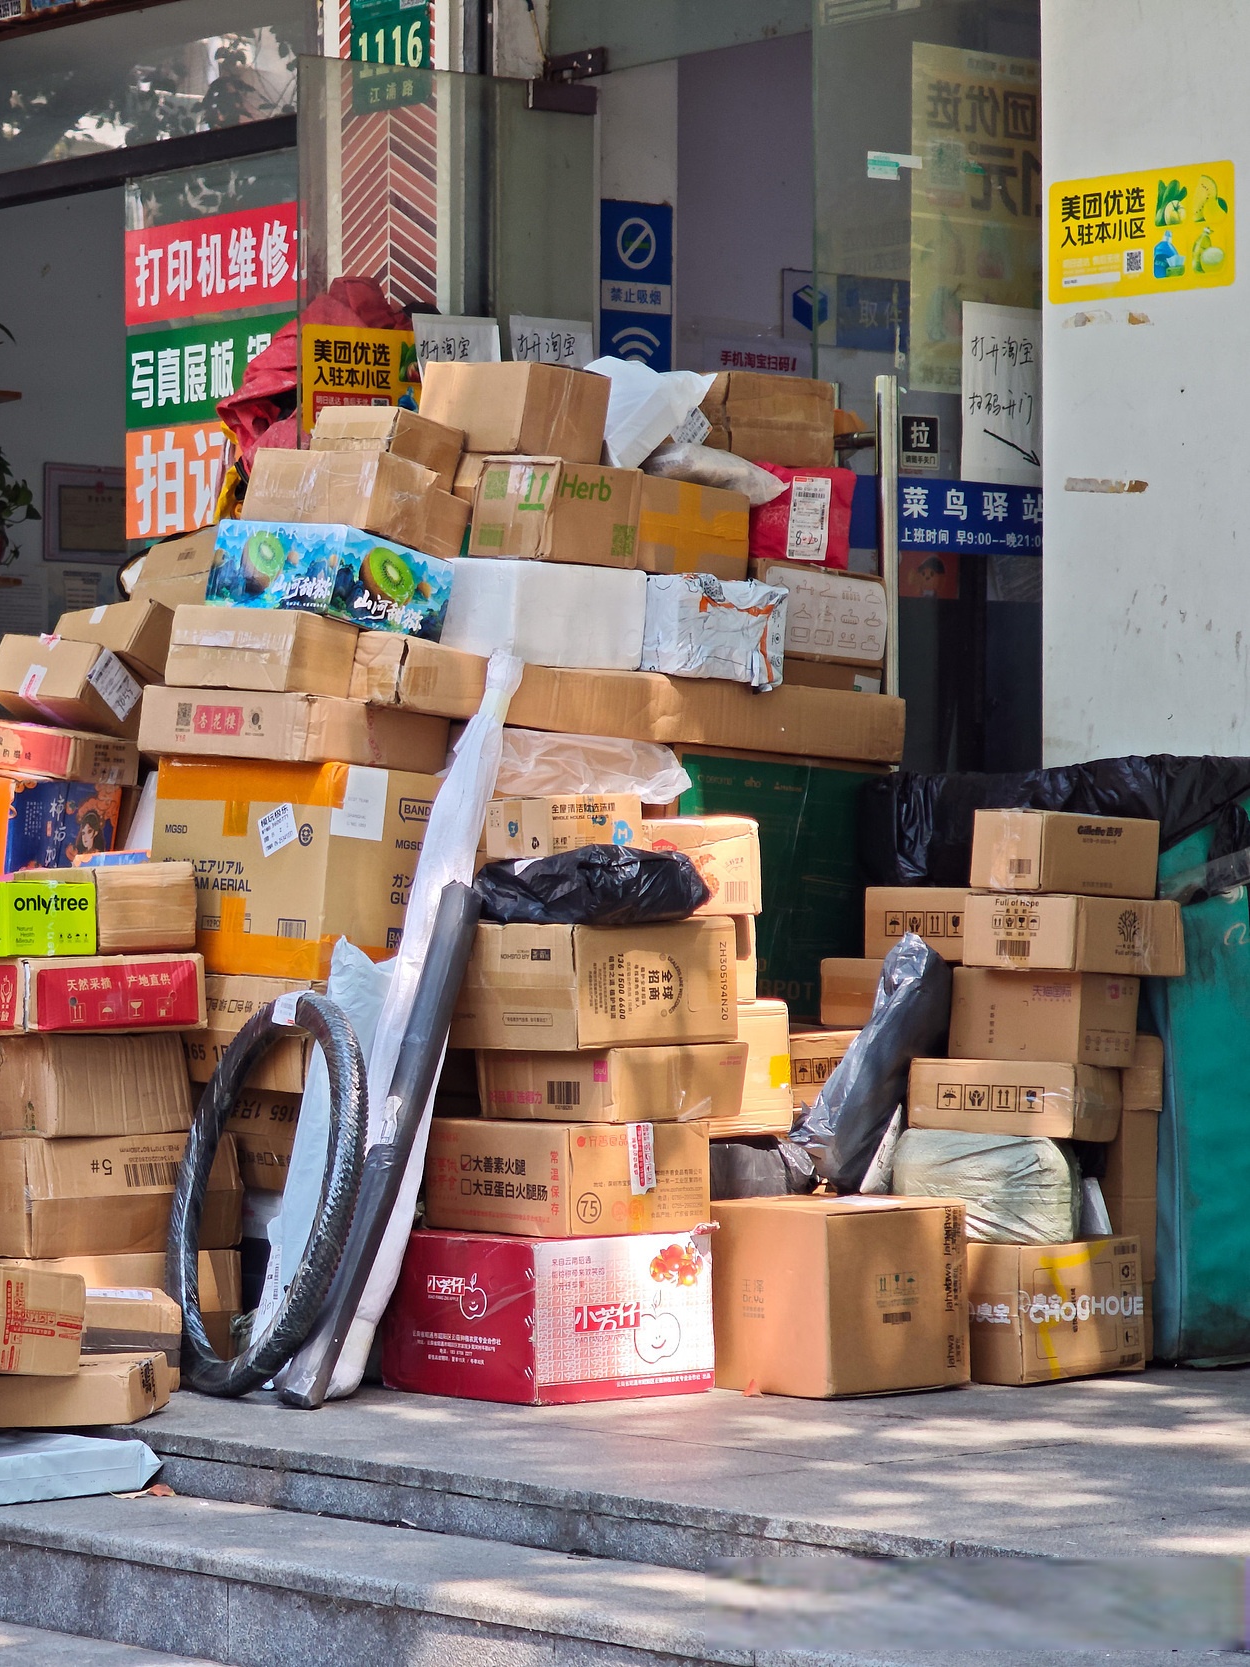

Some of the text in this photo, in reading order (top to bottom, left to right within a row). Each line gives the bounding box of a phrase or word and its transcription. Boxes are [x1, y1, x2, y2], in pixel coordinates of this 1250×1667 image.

[358, 21, 423, 76] 1116
[369, 79, 414, 104] 江浦路
[1060, 186, 1146, 222] 美团优选
[1060, 216, 1146, 248] 入驻本小区
[610, 286, 662, 306] 禁止吸烟
[313, 338, 391, 367] 美团优选
[419, 336, 470, 363] 打开淘宝
[517, 332, 576, 356] 打开淘宝
[971, 335, 1034, 376] 打开淘宝
[131, 337, 235, 409] 写真展板
[313, 366, 392, 390] 入驻本小区
[968, 389, 1034, 426] 扫码开门
[910, 421, 931, 448] 拉
[901, 527, 950, 545] 上班时间
[44, 794, 67, 869] 柿柿如
[164, 823, 188, 834] MGSD
[1077, 824, 1106, 837] Gillette
[211, 877, 252, 893] AERIAL
[13, 894, 89, 915] onlytree
[995, 898, 1040, 908] Full of Hope
[66, 972, 172, 992] 天然采摘 产地直供
[617, 953, 627, 1020] 136 1500 6600
[648, 970, 661, 1001] 招商
[661, 970, 674, 1000] 全球
[718, 941, 729, 1021] ZH305194N20
[90, 1158, 113, 1176] 5#
[472, 1155, 526, 1176] 大善素火腿
[472, 1179, 548, 1202] 大豆蛋白火腿肠
[549, 1150, 560, 1216] 常温保存
[580, 1200, 599, 1218] 75
[427, 1275, 466, 1295] 小芳仔
[742, 1294, 765, 1304] Dr.Yu
[575, 1301, 641, 1332] 小芳仔
